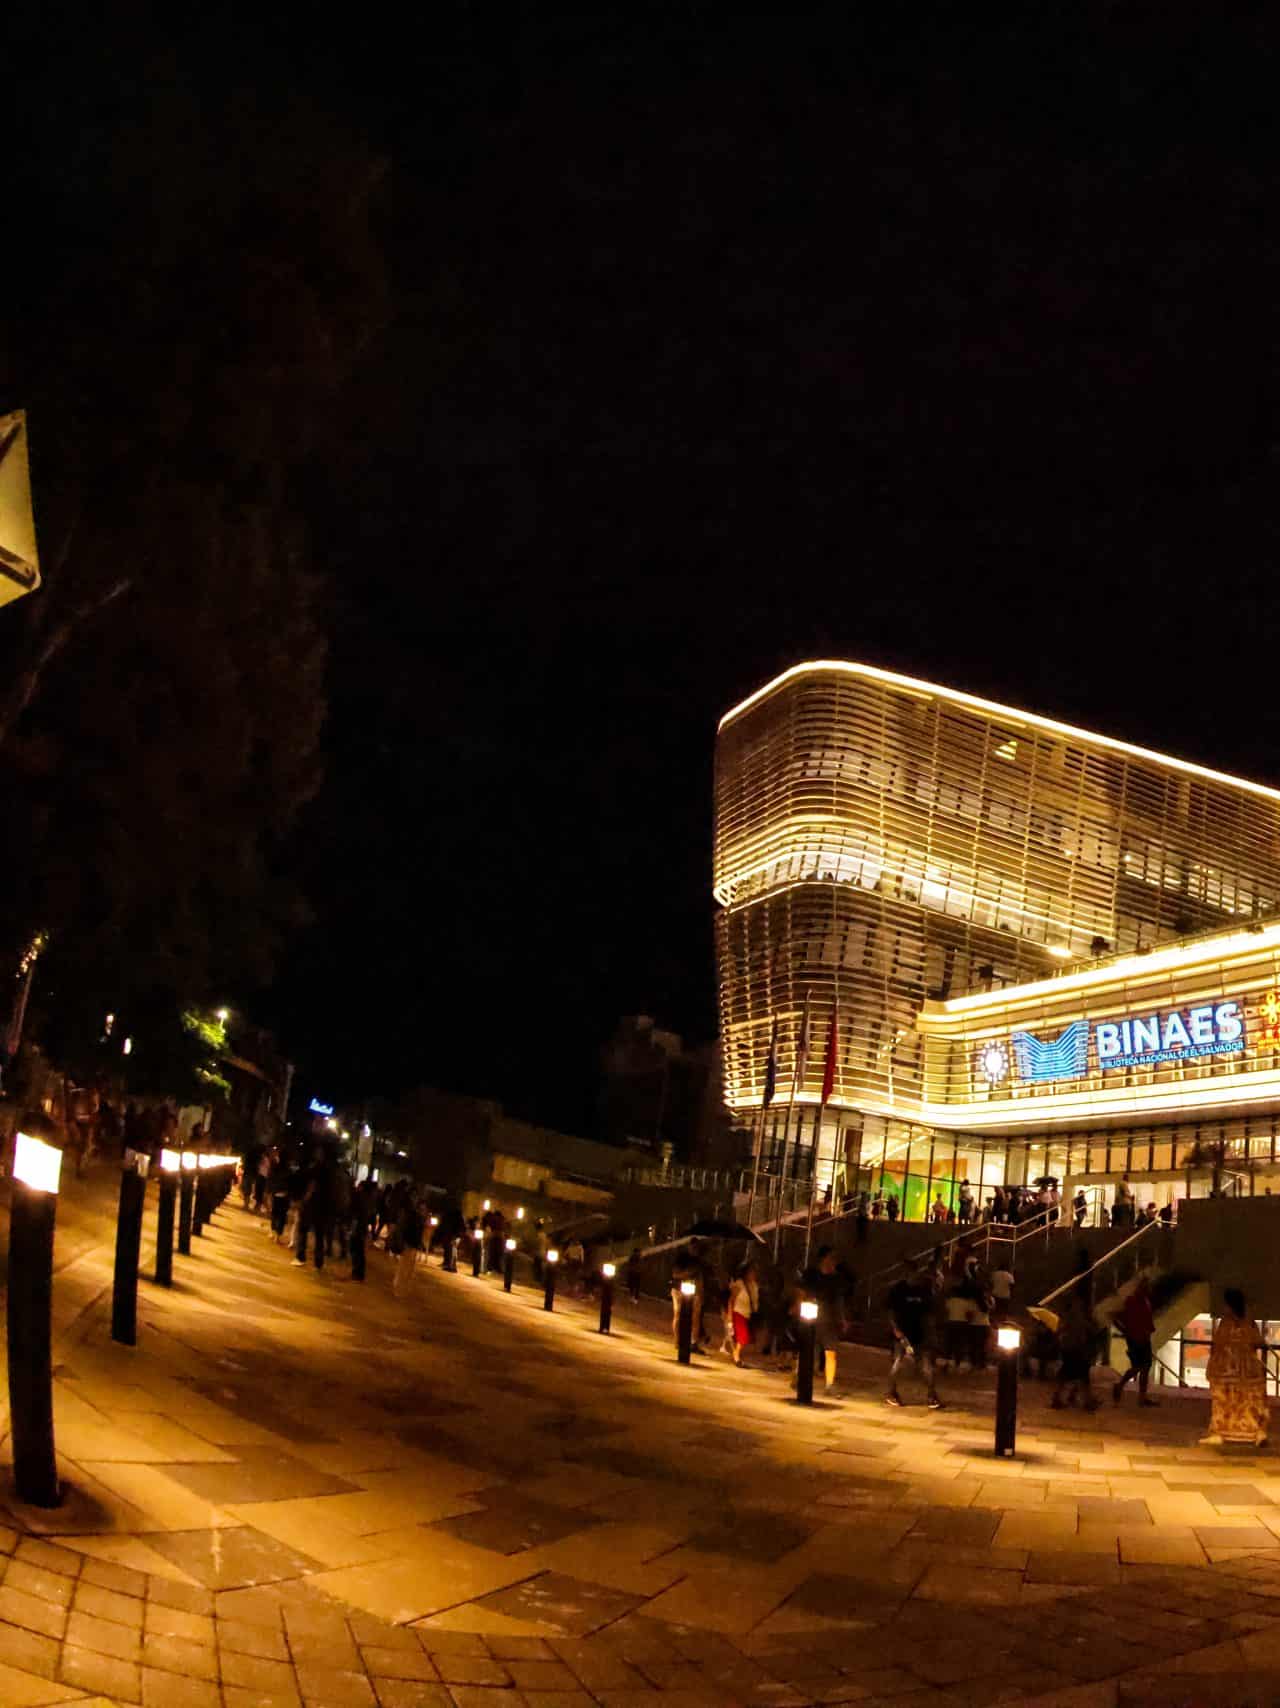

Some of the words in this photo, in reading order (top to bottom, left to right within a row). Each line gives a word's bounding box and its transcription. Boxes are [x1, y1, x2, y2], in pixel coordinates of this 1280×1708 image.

[1096, 1001, 1243, 1058] BINAES
[1140, 1051, 1178, 1064] NACIONAL
[1178, 1049, 1190, 1059] DE
[1190, 1047, 1199, 1057] EL
[1199, 1042, 1243, 1055] SALVADOR
